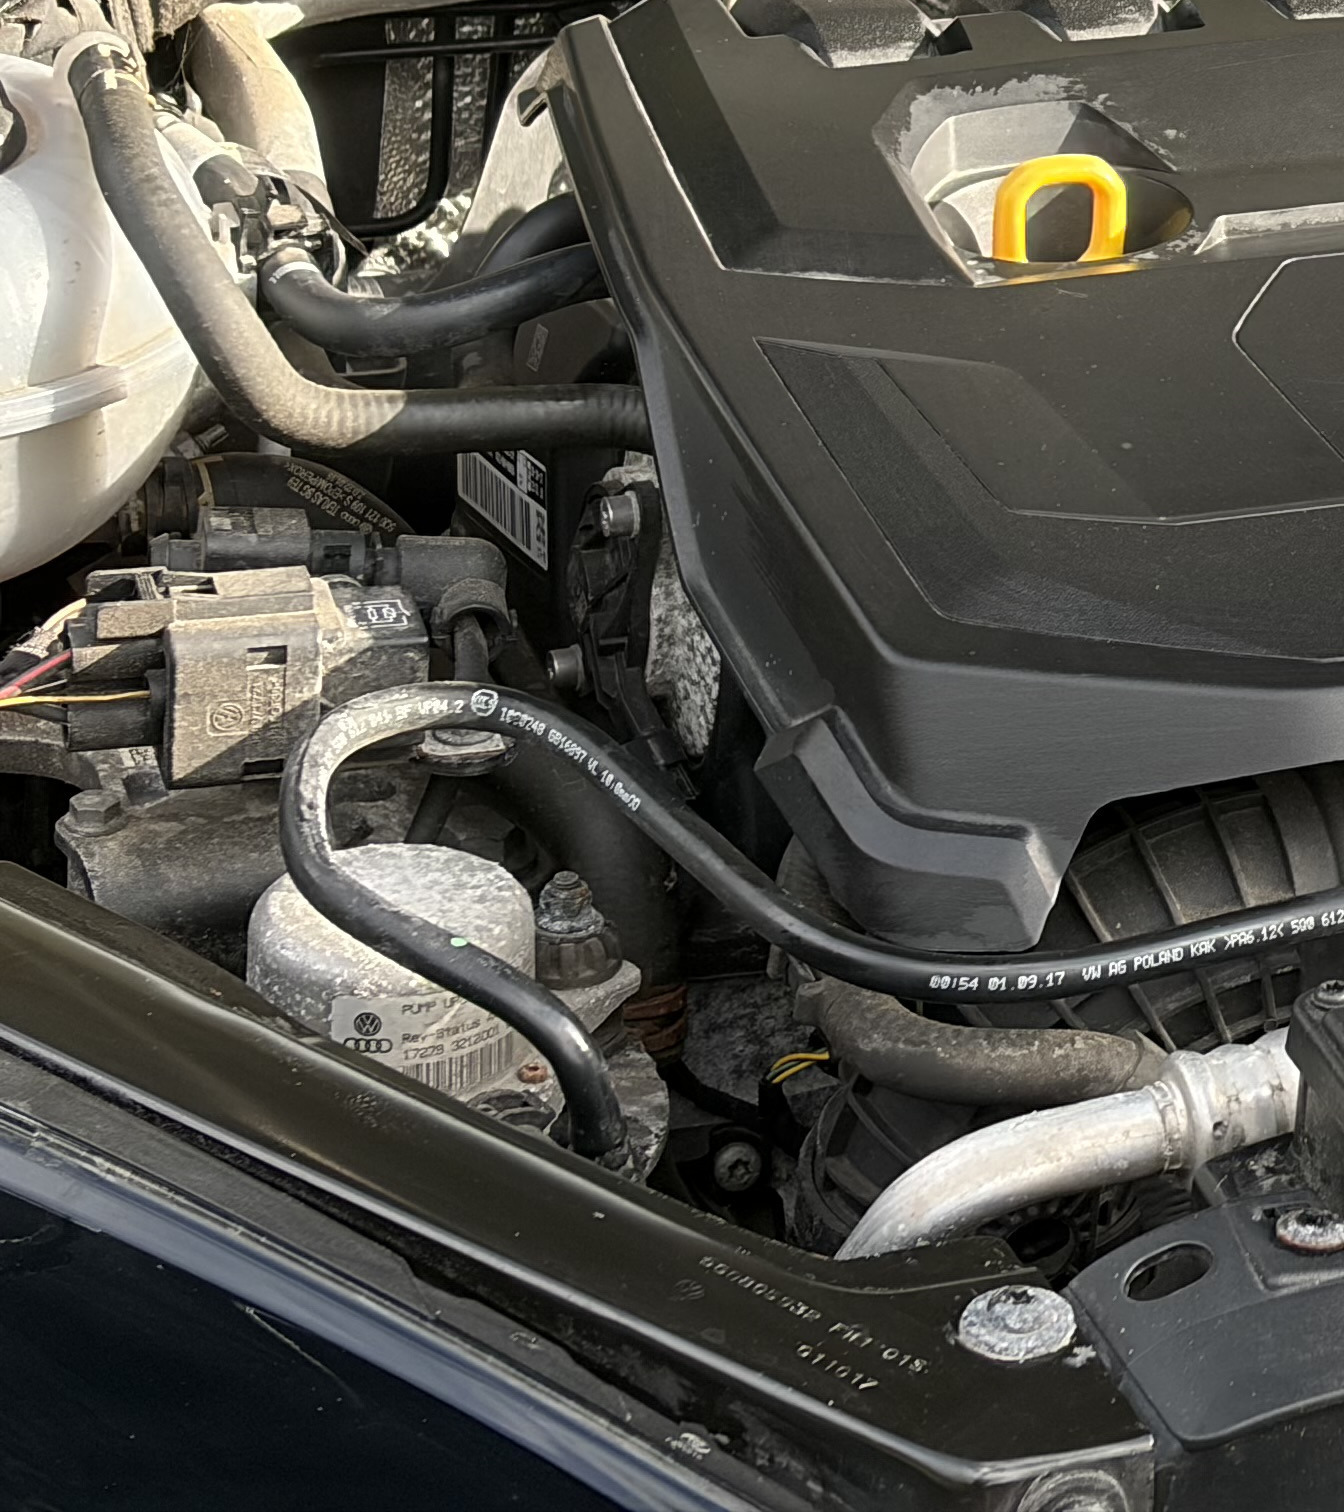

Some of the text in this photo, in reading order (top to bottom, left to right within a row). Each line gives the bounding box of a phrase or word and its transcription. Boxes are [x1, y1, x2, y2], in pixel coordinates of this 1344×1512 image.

[987, 970, 1066, 992] 01.09.17
[1081, 966, 1102, 981] VW
[1107, 960, 1128, 978] AG
[1133, 946, 1184, 972] POLAND
[353, 1011, 383, 1037] VW
